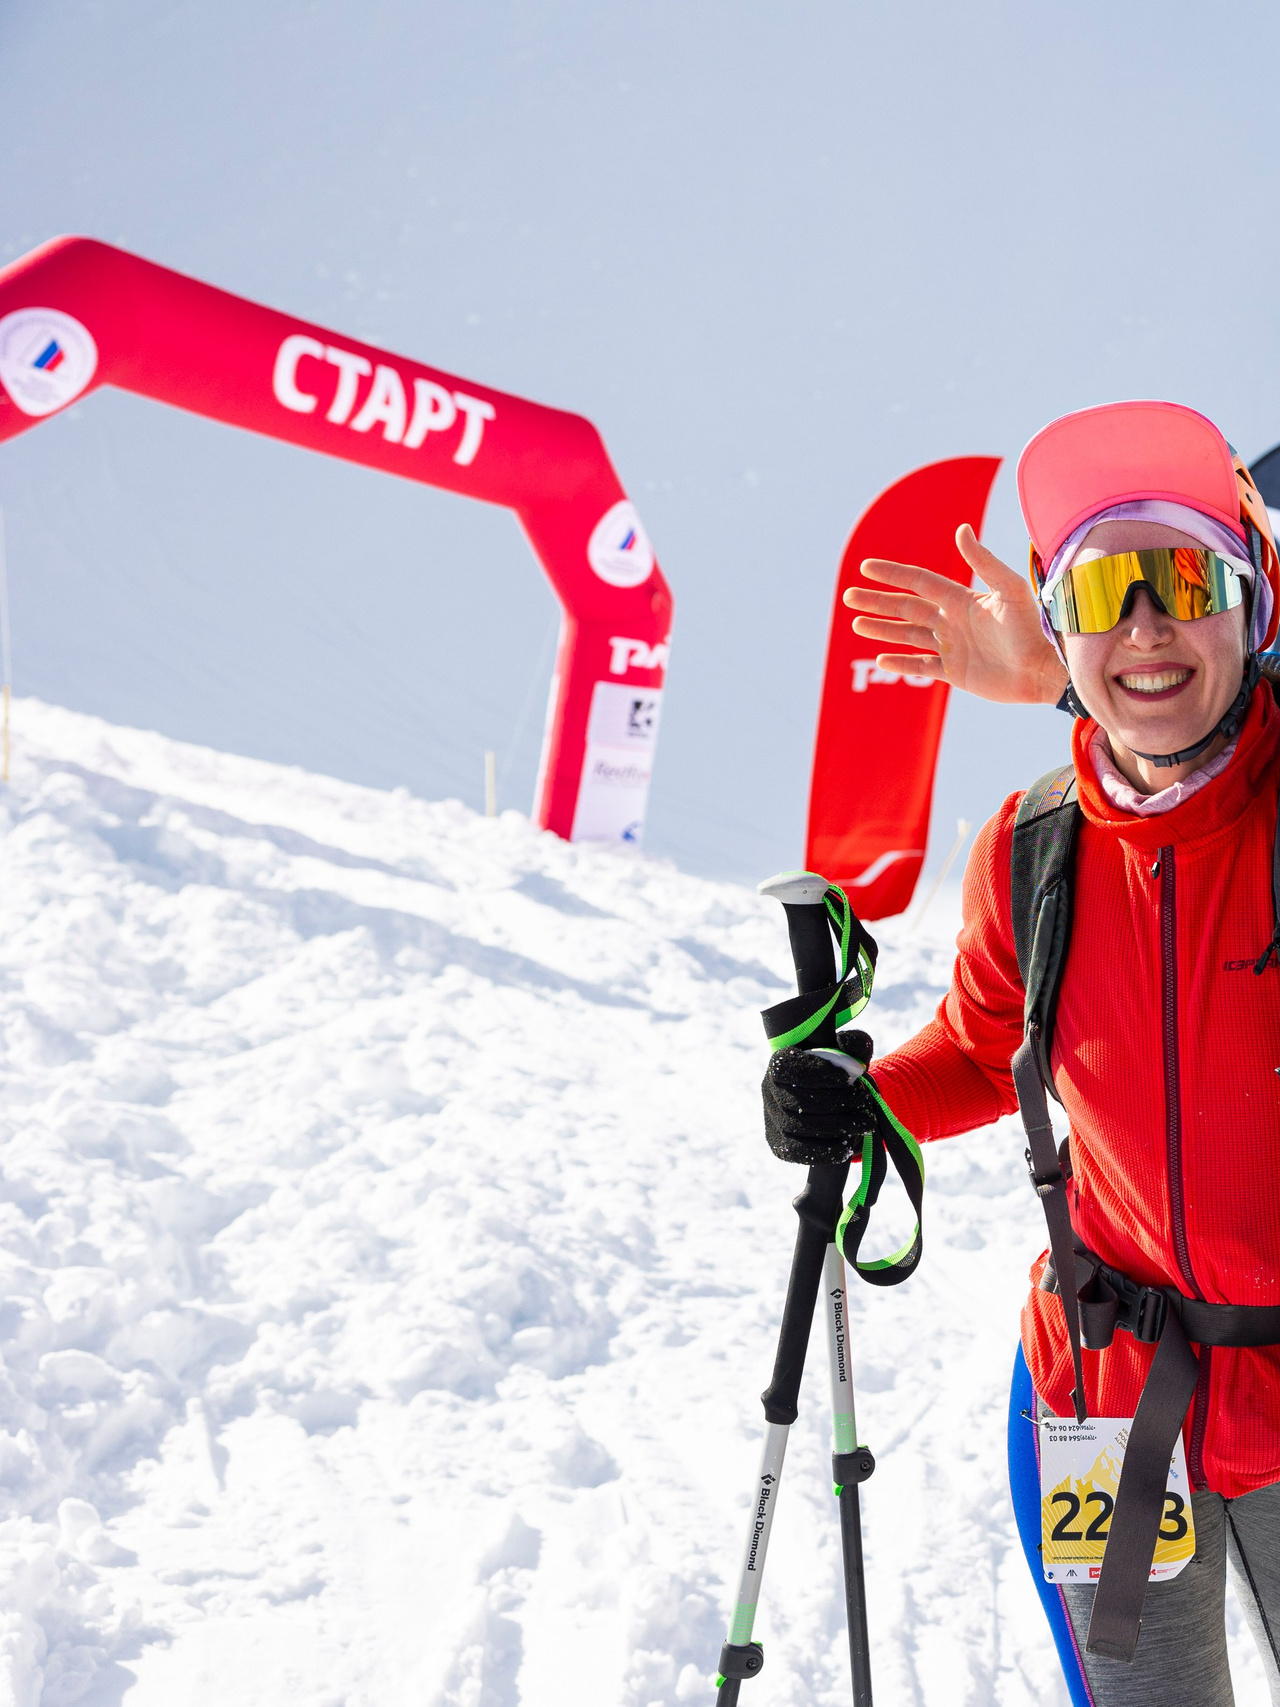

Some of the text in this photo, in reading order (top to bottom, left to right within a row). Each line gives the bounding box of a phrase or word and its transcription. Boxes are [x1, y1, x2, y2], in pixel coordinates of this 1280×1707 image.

[272, 333, 497, 467] СТАРТ
[834, 1302, 847, 1382] Black Diamond
[747, 1488, 771, 1572] Black Diamond
[1051, 1491, 1188, 1541] 223
